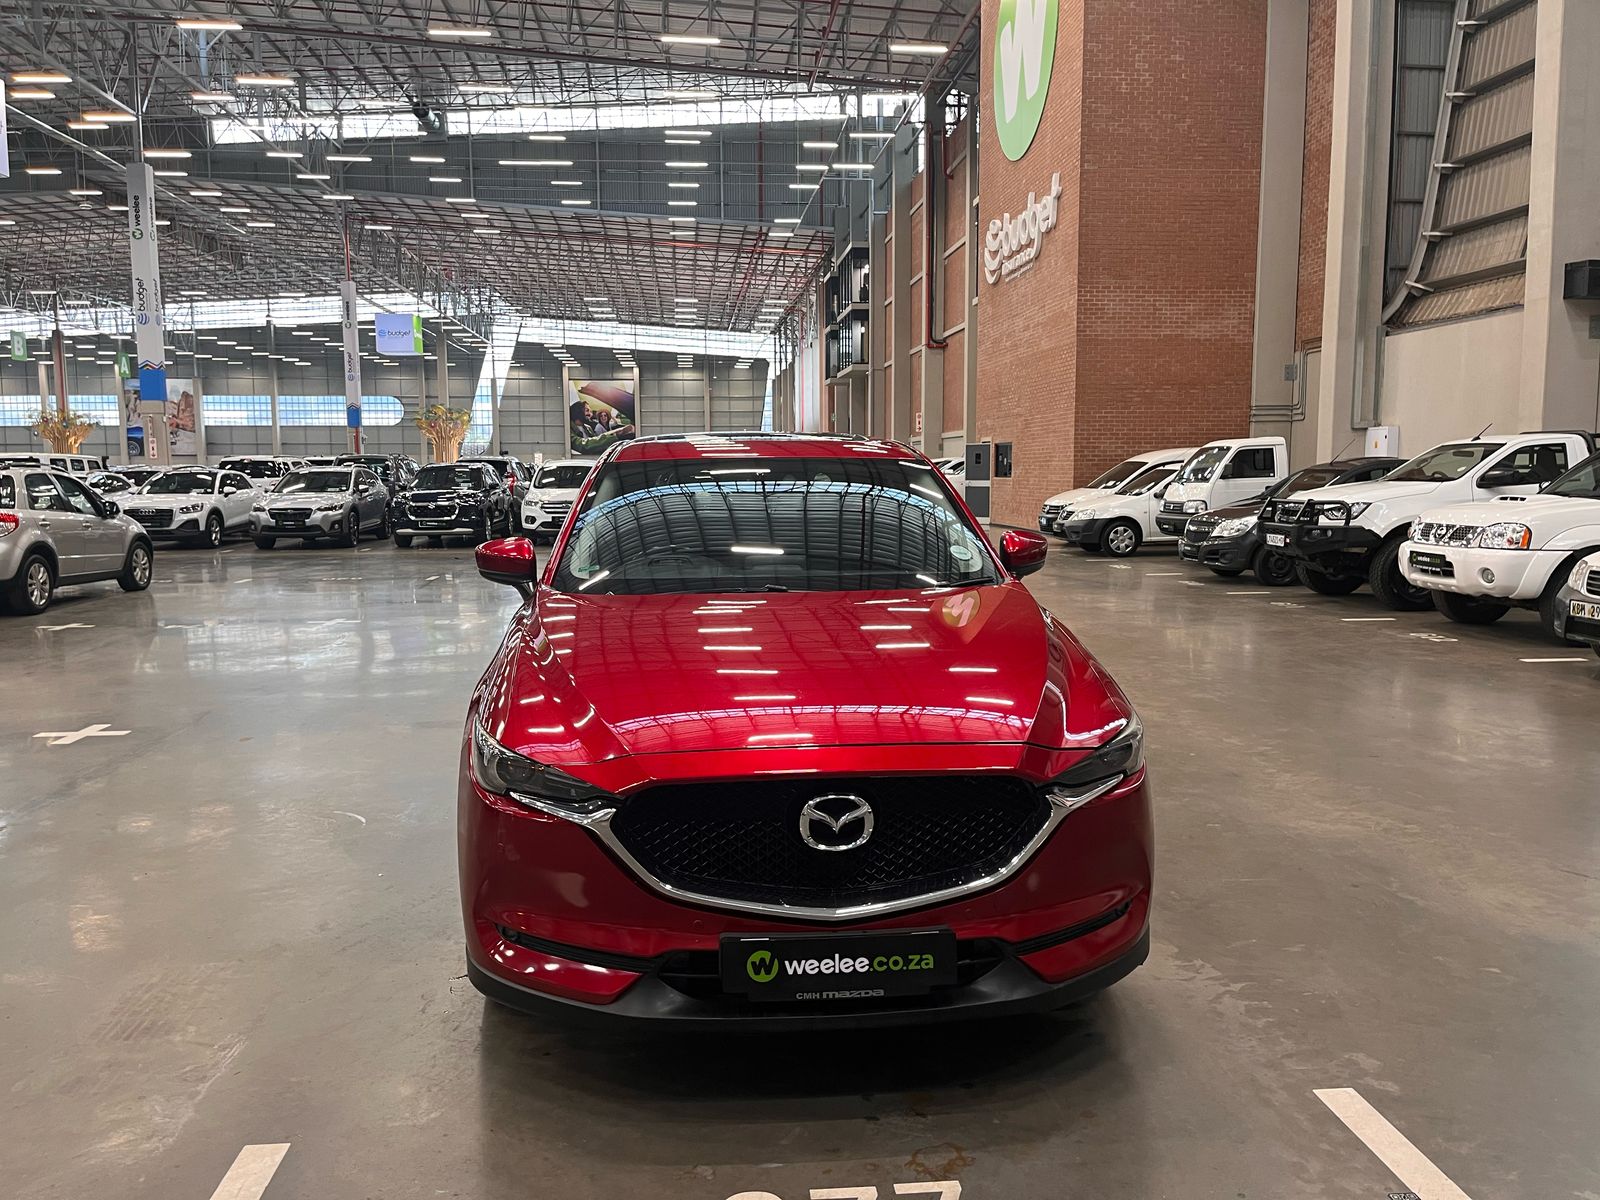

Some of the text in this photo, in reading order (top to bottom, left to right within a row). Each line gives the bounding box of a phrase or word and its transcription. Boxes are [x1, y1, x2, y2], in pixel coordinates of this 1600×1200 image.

[133, 195, 141, 227] weelee
[1002, 171, 1062, 260] budget
[136, 277, 147, 312] budget
[387, 329, 411, 337] budget
[14, 336, 24, 356] B
[120, 358, 129, 374] A
[1572, 602, 1586, 616] KBM
[784, 953, 935, 976] weelee.co.za
[796, 988, 885, 1000] CMH mazda
